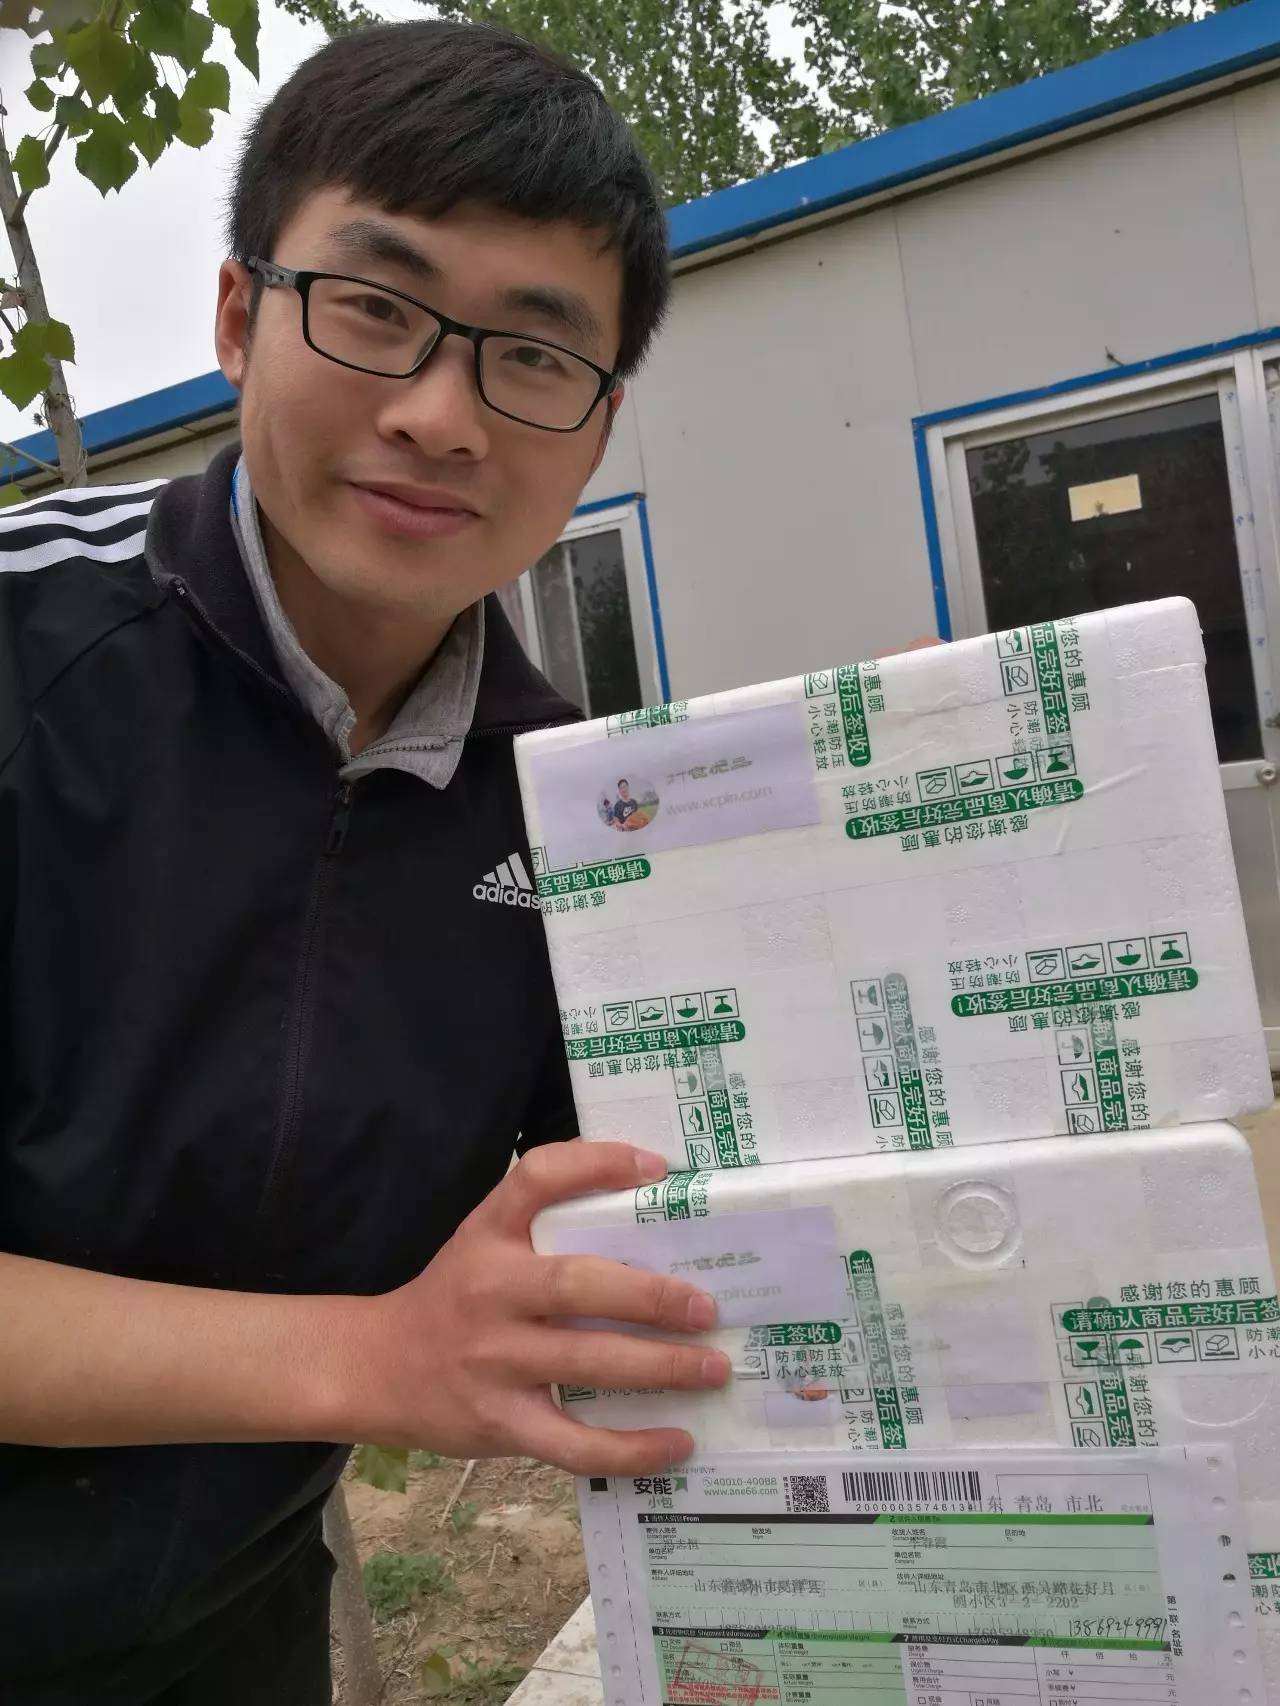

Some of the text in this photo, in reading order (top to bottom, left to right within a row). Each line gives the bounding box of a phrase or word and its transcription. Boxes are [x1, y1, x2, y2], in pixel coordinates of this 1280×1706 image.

[808, 705, 828, 770] 小心轻放
[823, 703, 845, 768] 防潮防压
[840, 775, 909, 798] 小心轻放
[842, 791, 911, 815] 防潮防压
[850, 781, 1076, 836] 请确认商品完好后签收!
[899, 814, 1029, 852] 感谢您的惠顾
[473, 883, 541, 910] adidas
[947, 954, 1018, 975] 小心轻放
[948, 970, 1020, 991] 防潮防压
[957, 969, 1190, 1014] 请确认商品完好后签收!
[1007, 1001, 1140, 1033] 感谢您的惠顾
[588, 1050, 698, 1078] 感谢您的惠顾
[886, 981, 931, 1146] 请确认商品完好后
[918, 1026, 954, 1146] 感谢您的惠顾
[1120, 1277, 1260, 1303] 感谢您的惠顾
[1071, 1300, 1280, 1332] 请确认商品完好后签
[775, 1348, 842, 1363] 防潮防压
[777, 1363, 845, 1379] 小心轻放
[845, 1410, 860, 1449] 小心
[634, 1477, 673, 1495] 安能
[648, 1497, 674, 1509] 小包
[1014, 1495, 1052, 1513] 青岛
